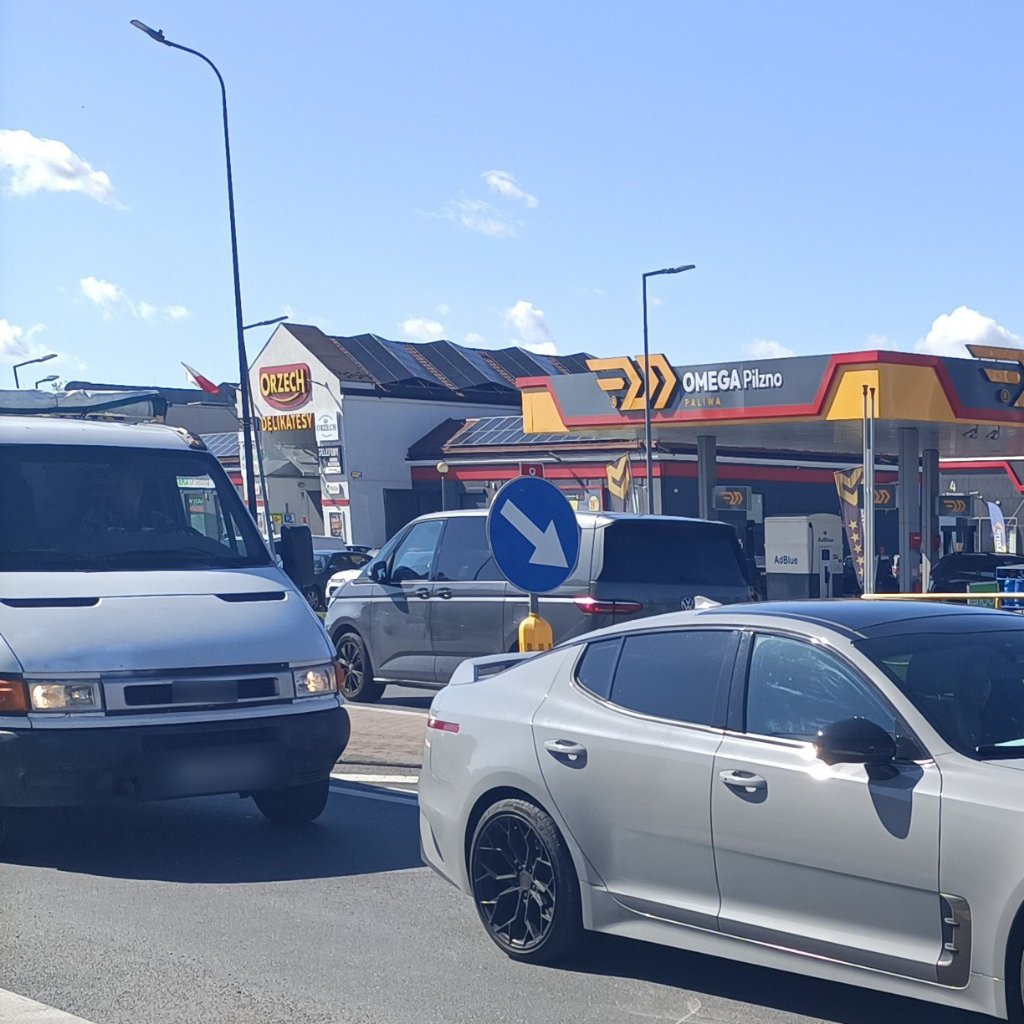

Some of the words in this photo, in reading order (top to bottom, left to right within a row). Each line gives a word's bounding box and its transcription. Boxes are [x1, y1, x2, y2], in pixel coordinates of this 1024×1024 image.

[259, 368, 306, 397] ORZECH
[682, 368, 742, 393] OMEGA
[743, 368, 783, 389] Pilzno
[683, 396, 722, 408] PALIWA
[262, 413, 313, 431] DELIKATESY
[949, 480, 957, 492] 4
[773, 554, 799, 565] AdBlue
